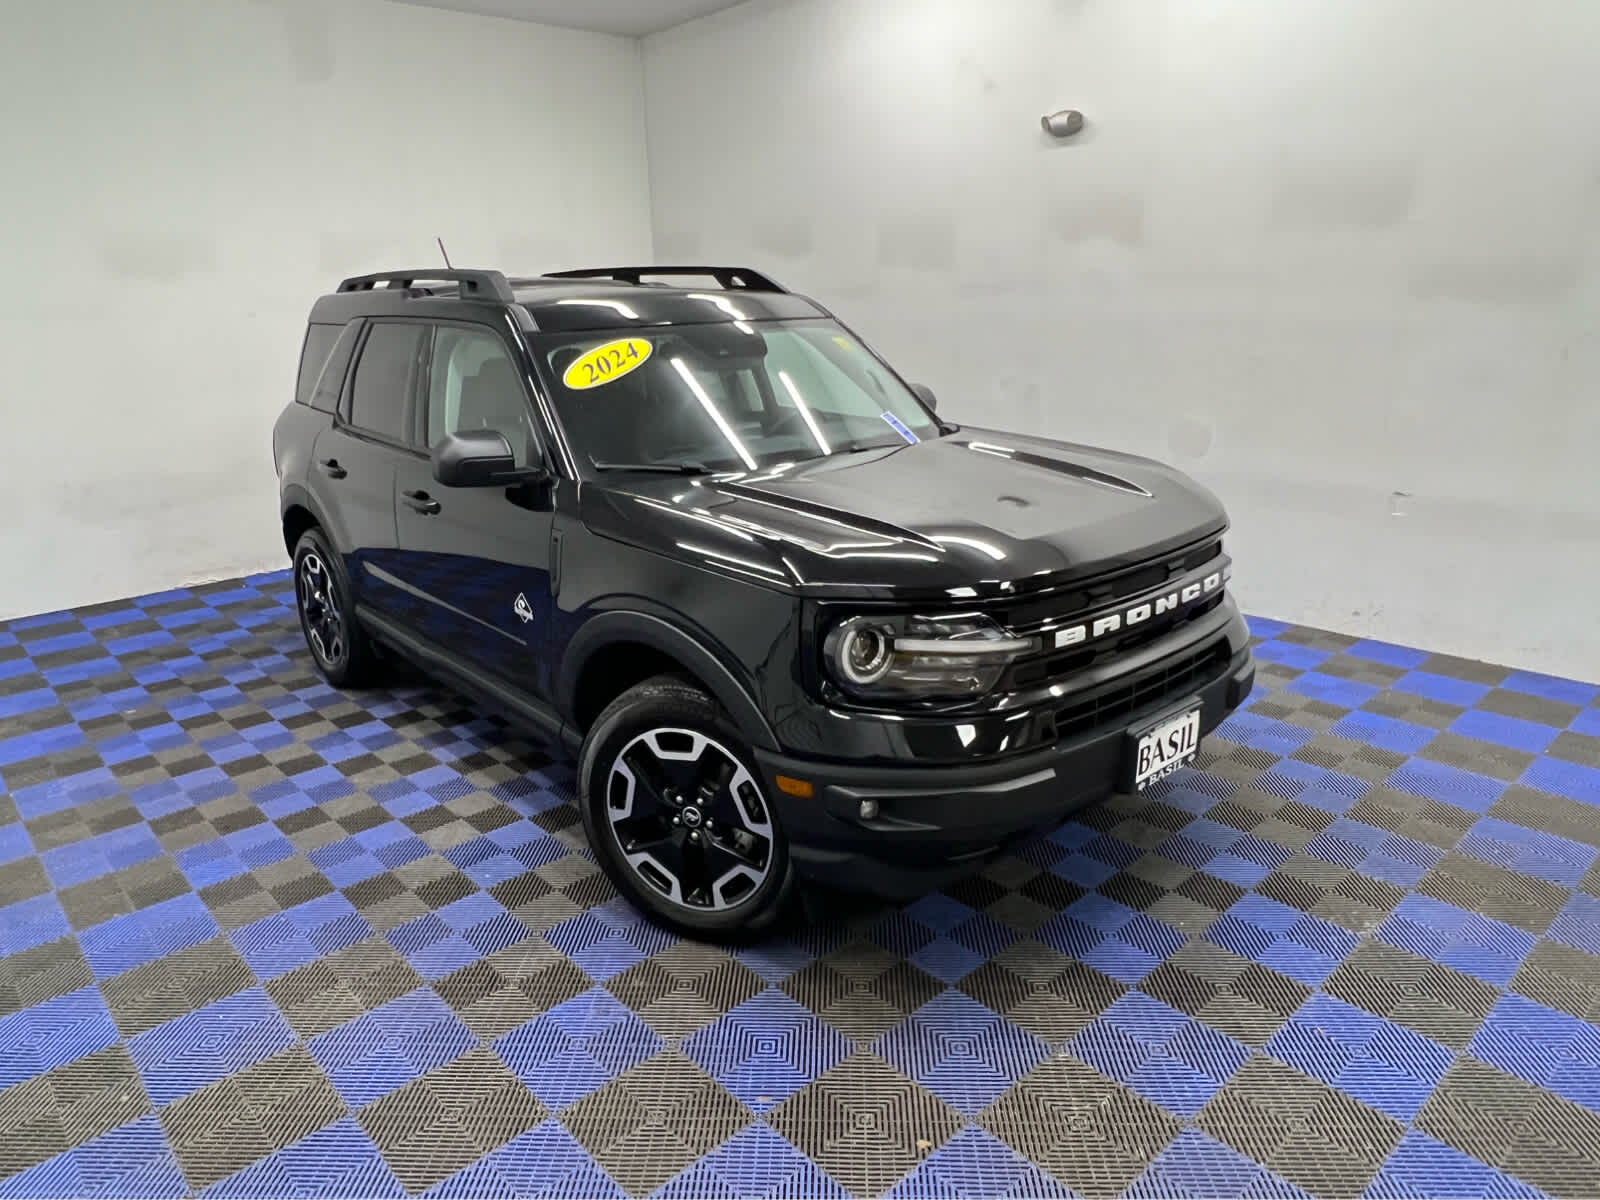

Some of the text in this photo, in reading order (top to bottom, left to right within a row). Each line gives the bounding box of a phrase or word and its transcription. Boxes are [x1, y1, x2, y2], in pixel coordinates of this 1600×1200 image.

[582, 341, 640, 384] 2024
[1054, 572, 1220, 649] BRONCO
[1138, 722, 1195, 776] BASIL
[1148, 759, 1185, 786] BASIL
